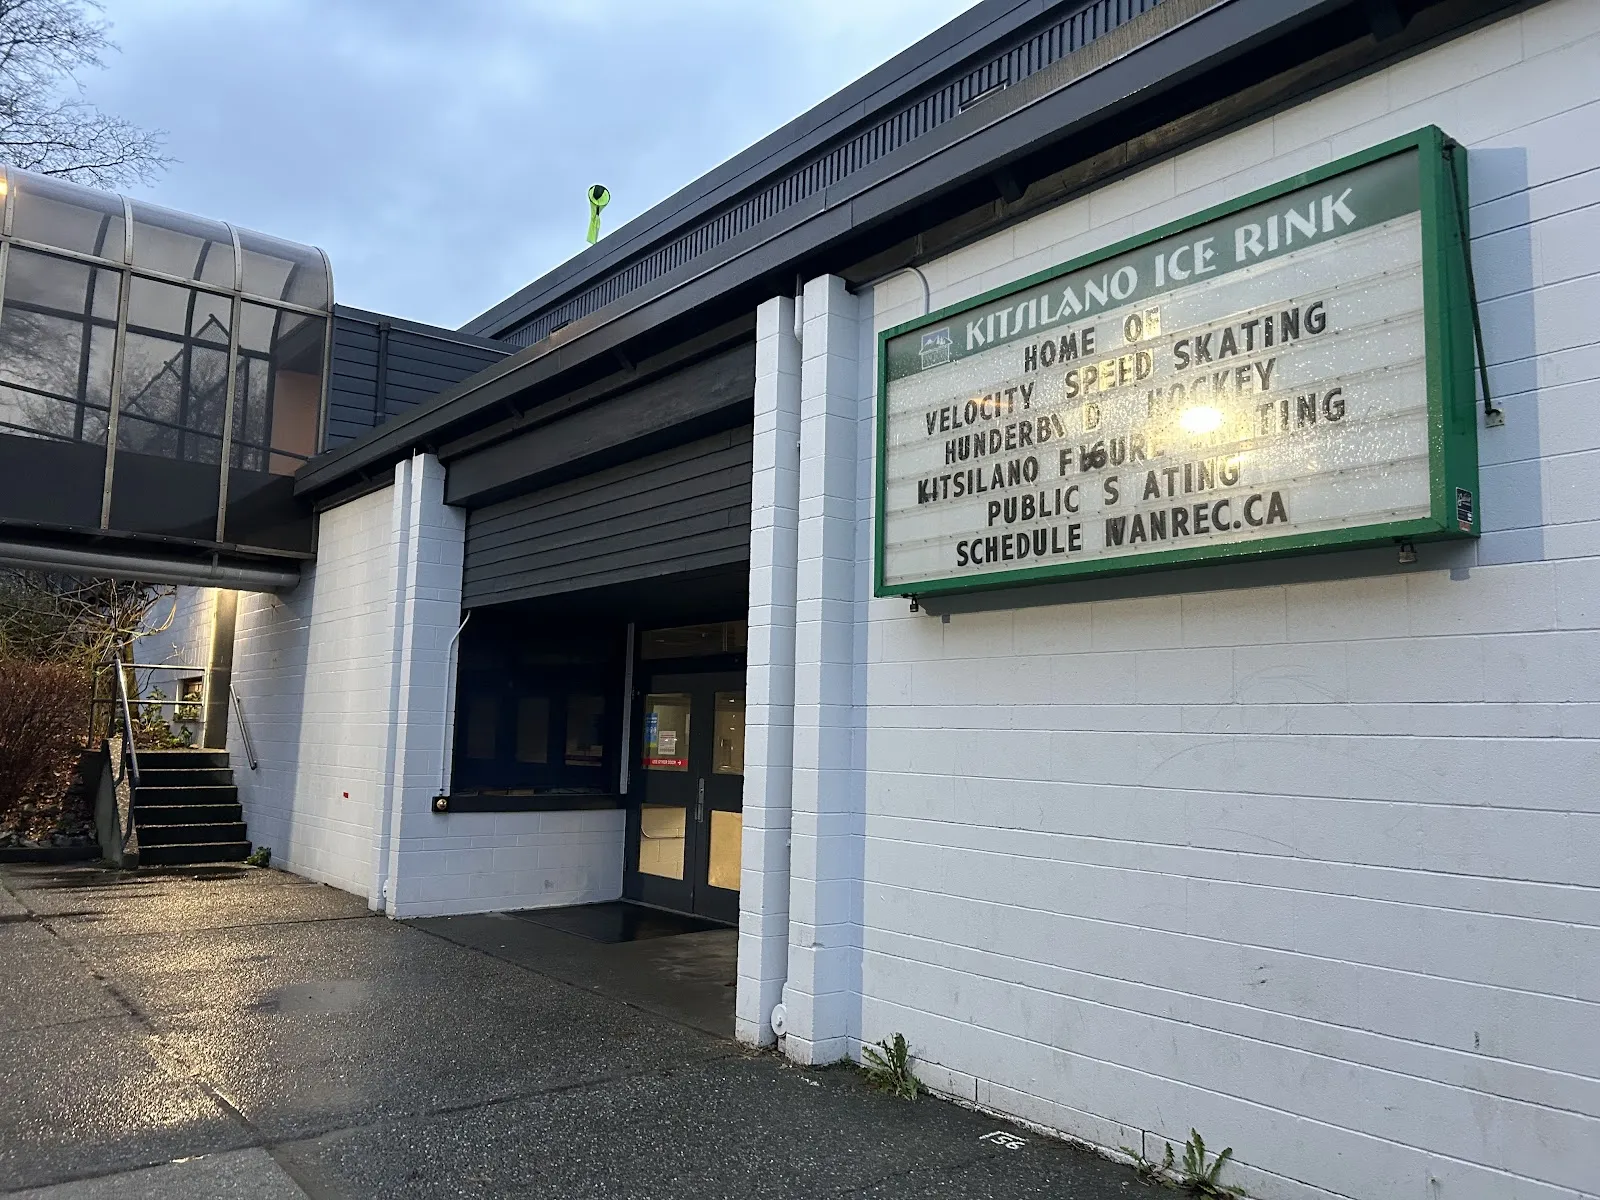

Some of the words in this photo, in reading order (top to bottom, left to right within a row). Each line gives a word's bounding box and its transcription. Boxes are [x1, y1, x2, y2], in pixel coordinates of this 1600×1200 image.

[965, 265, 1139, 350] KITSILANO
[1154, 237, 1216, 287] ICE
[1234, 188, 1357, 262] RINK
[925, 381, 1035, 435] VELOCITY
[1064, 350, 1151, 399] SPEED
[1173, 300, 1327, 371] SKATING
[1024, 326, 1095, 373] HOME
[917, 456, 1039, 504] KITSILANO
[987, 485, 1080, 527] PUBLIC
[956, 523, 1082, 567] SCHEDULE
